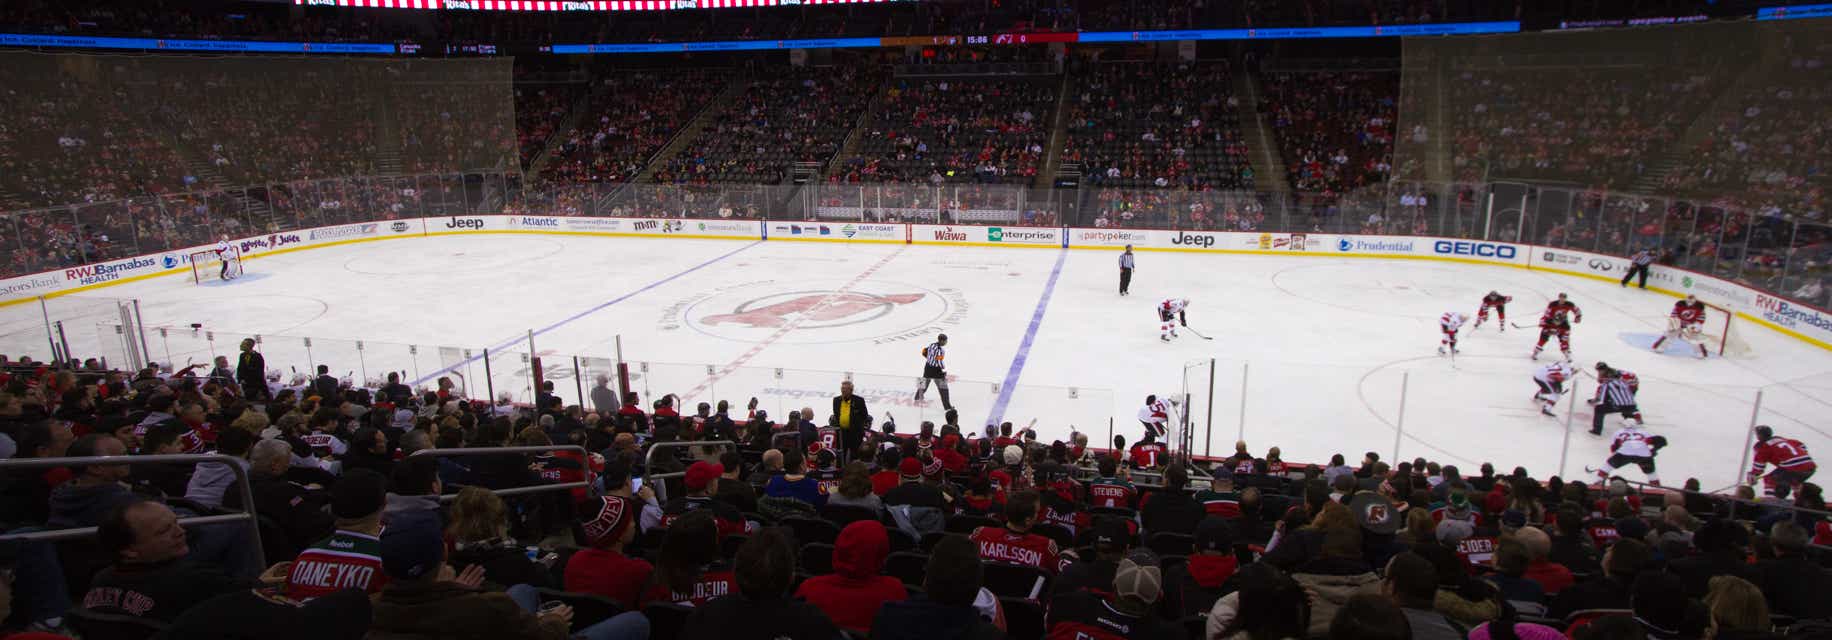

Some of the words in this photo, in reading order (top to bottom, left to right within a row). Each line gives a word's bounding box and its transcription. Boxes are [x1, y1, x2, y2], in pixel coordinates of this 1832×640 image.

[447, 216, 484, 229] Jeep
[522, 217, 559, 226] Atlantic
[934, 230, 967, 241] Wawa
[1172, 232, 1215, 248] Jeep
[1357, 241, 1413, 252] Prudential
[1435, 240, 1516, 259] GEICO
[80, 273, 119, 285] HEALTH
[1777, 442, 1799, 456] 7
[1149, 451, 1155, 467] 1
[1094, 486, 1124, 497] STEVENS
[980, 540, 1042, 567] KARLSSON
[291, 560, 375, 592] DANEYKO
